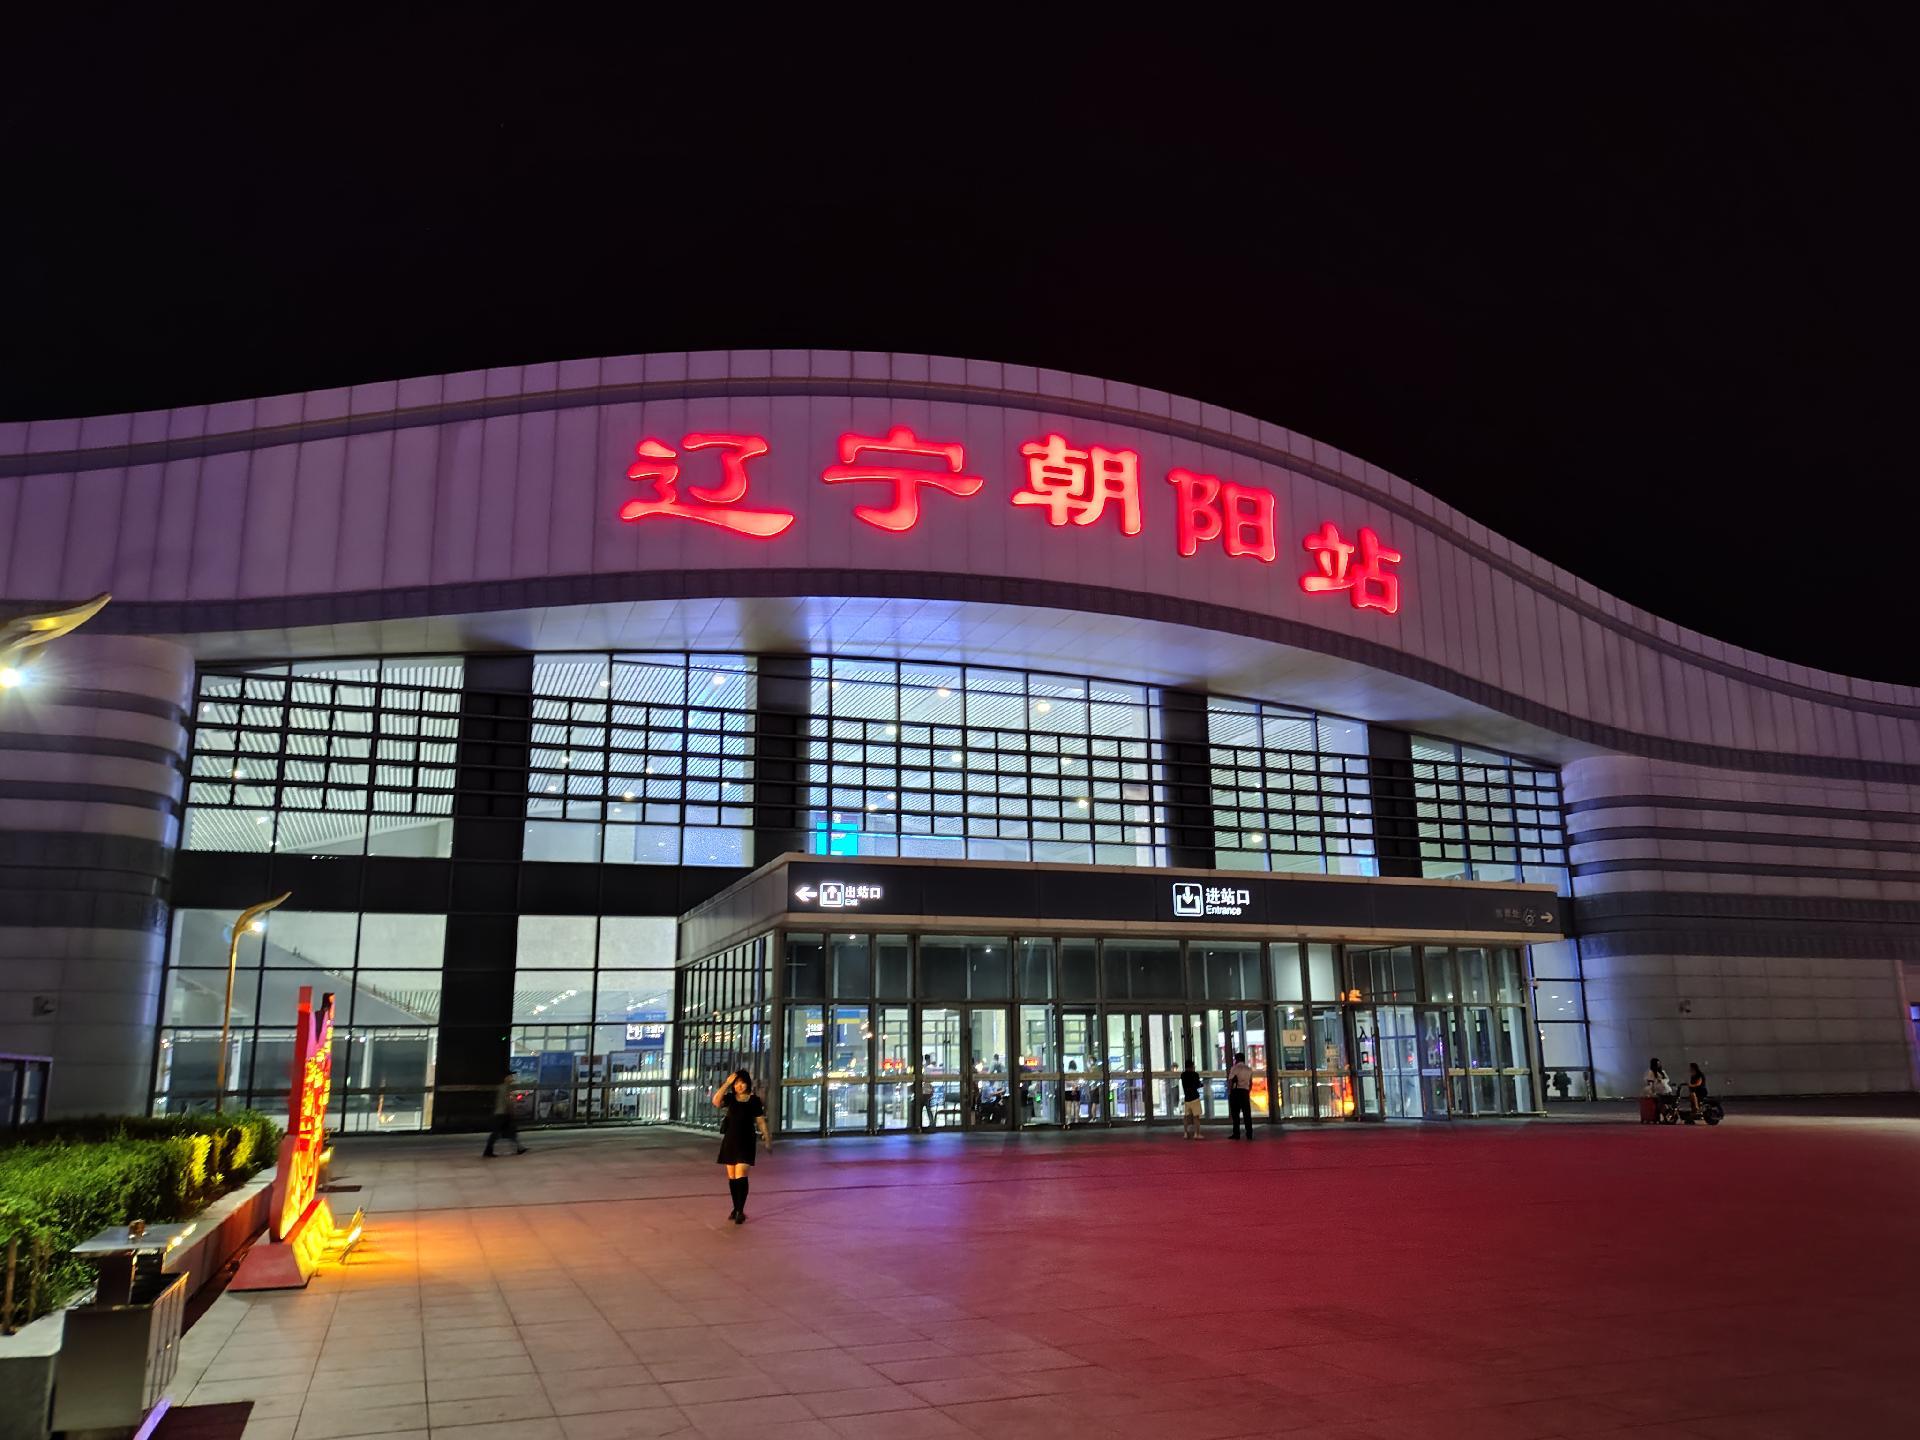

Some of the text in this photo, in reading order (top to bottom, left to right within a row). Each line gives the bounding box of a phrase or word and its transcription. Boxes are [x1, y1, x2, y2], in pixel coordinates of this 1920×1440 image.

[620, 425, 1402, 614] 辽宁朝阳站
[845, 885, 882, 899] 出站口
[1205, 887, 1250, 905] 进站口
[1205, 905, 1242, 916] Entrance
